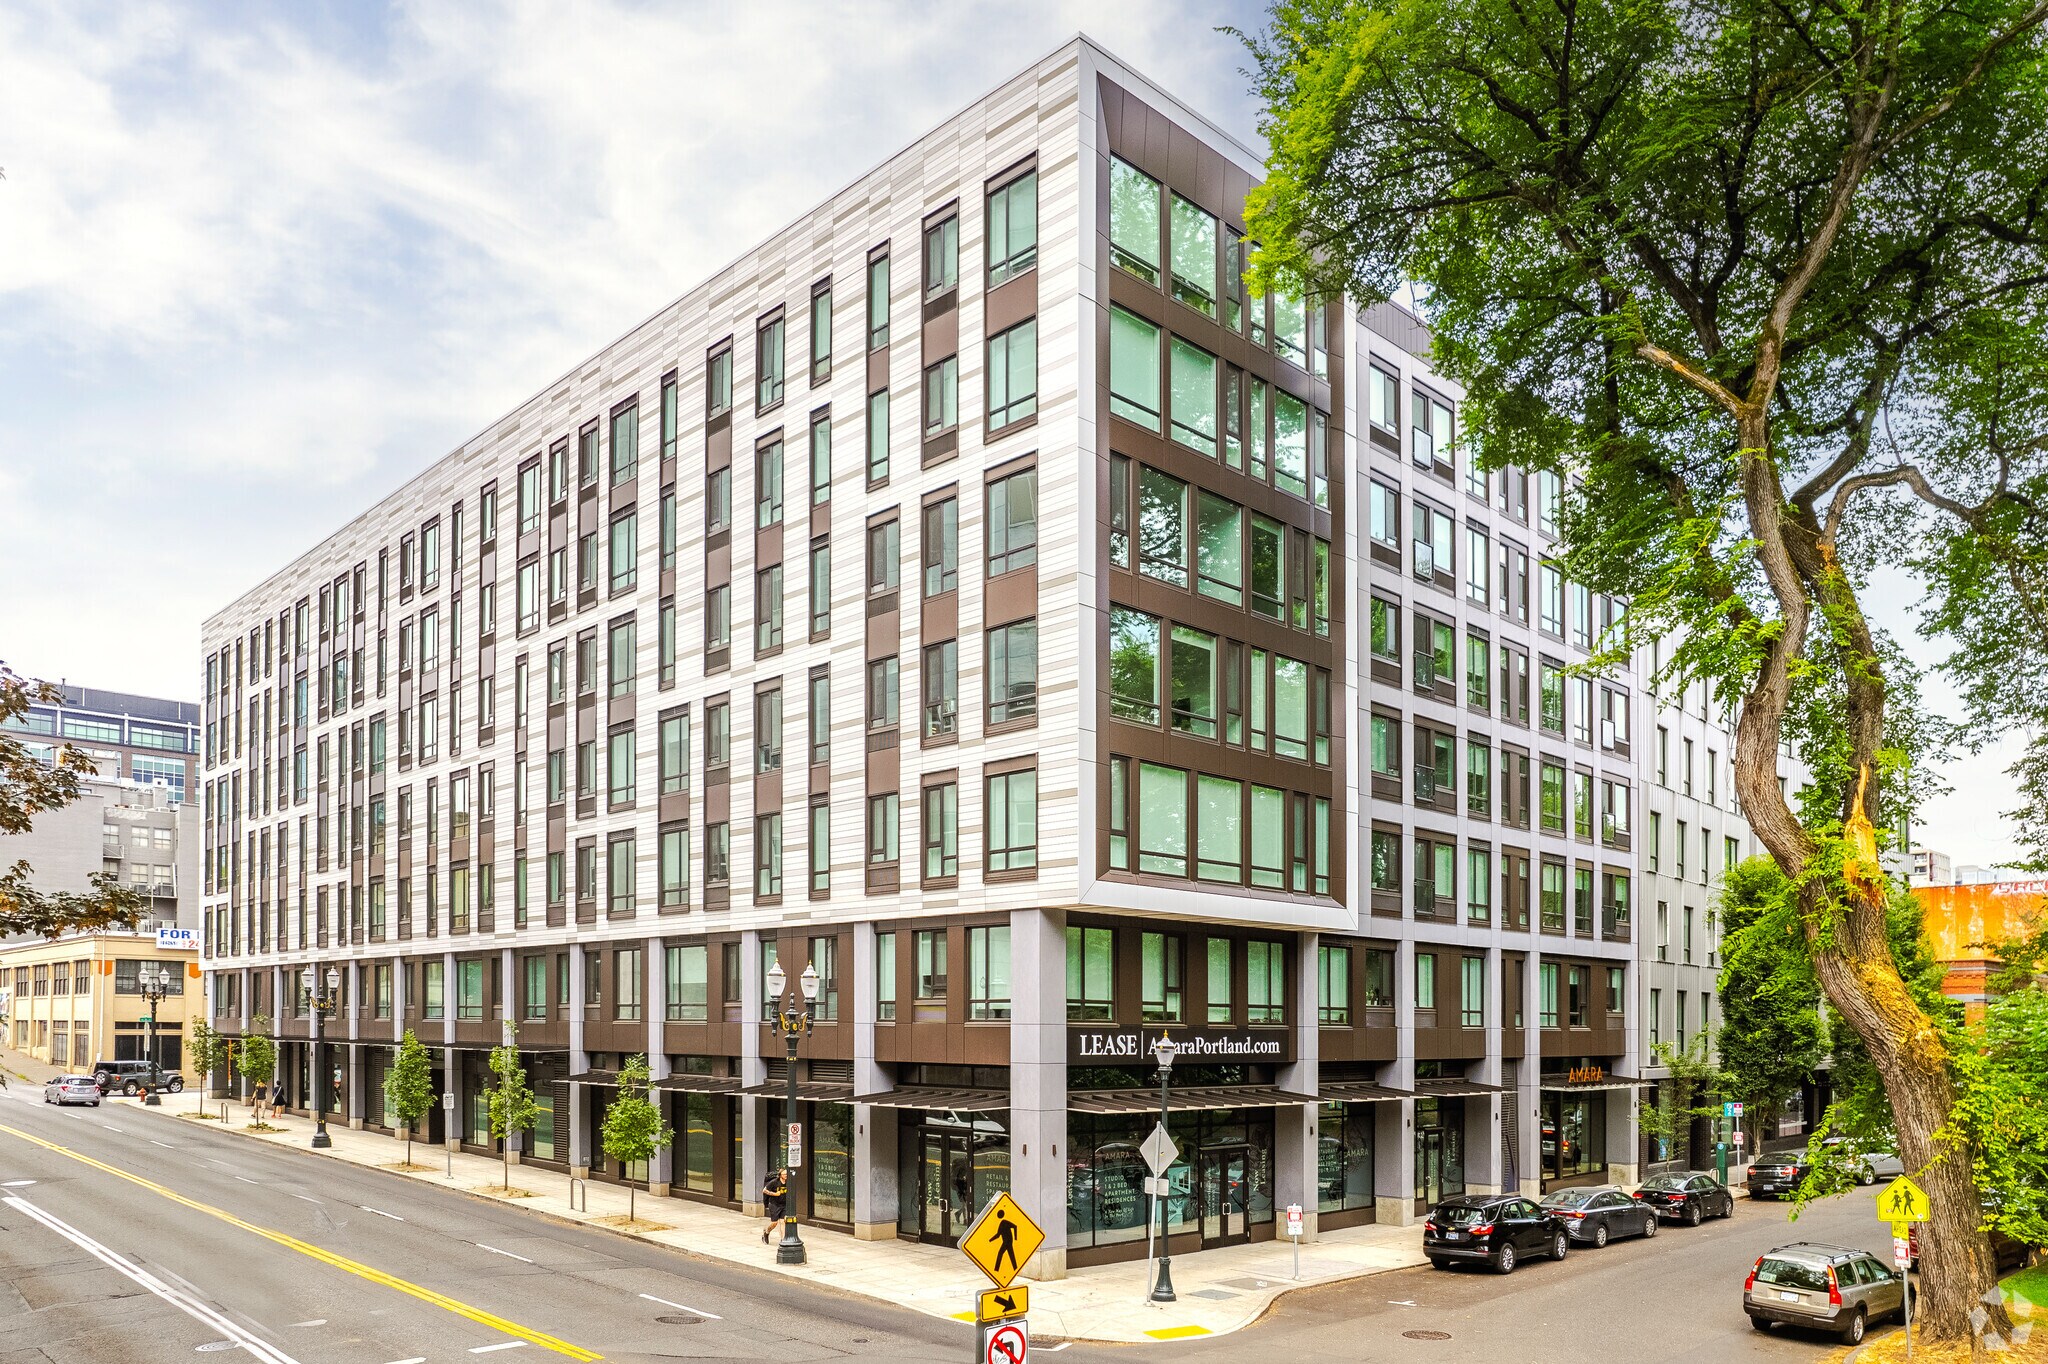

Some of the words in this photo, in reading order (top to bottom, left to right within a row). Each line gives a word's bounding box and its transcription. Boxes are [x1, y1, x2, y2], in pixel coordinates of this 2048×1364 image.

[160, 930, 190, 939] FOR
[1079, 1034, 1138, 1056] LEASE
[1147, 1036, 1280, 1055] AaraPortland.com
[1568, 1066, 1603, 1083] AMARA
[1105, 1151, 1130, 1160] AMARA
[1346, 1147, 1369, 1157] AMARA
[818, 1171, 843, 1179] APARTMENT
[985, 1173, 1004, 1181] RETAIL
[818, 1177, 844, 1186] RESIDENCES
[985, 1181, 1011, 1189] RESTAUR
[1117, 1181, 1128, 1189] BED
[1104, 1189, 1135, 1197] APARTMENT
[1104, 1196, 1136, 1204] RESIDENCES
